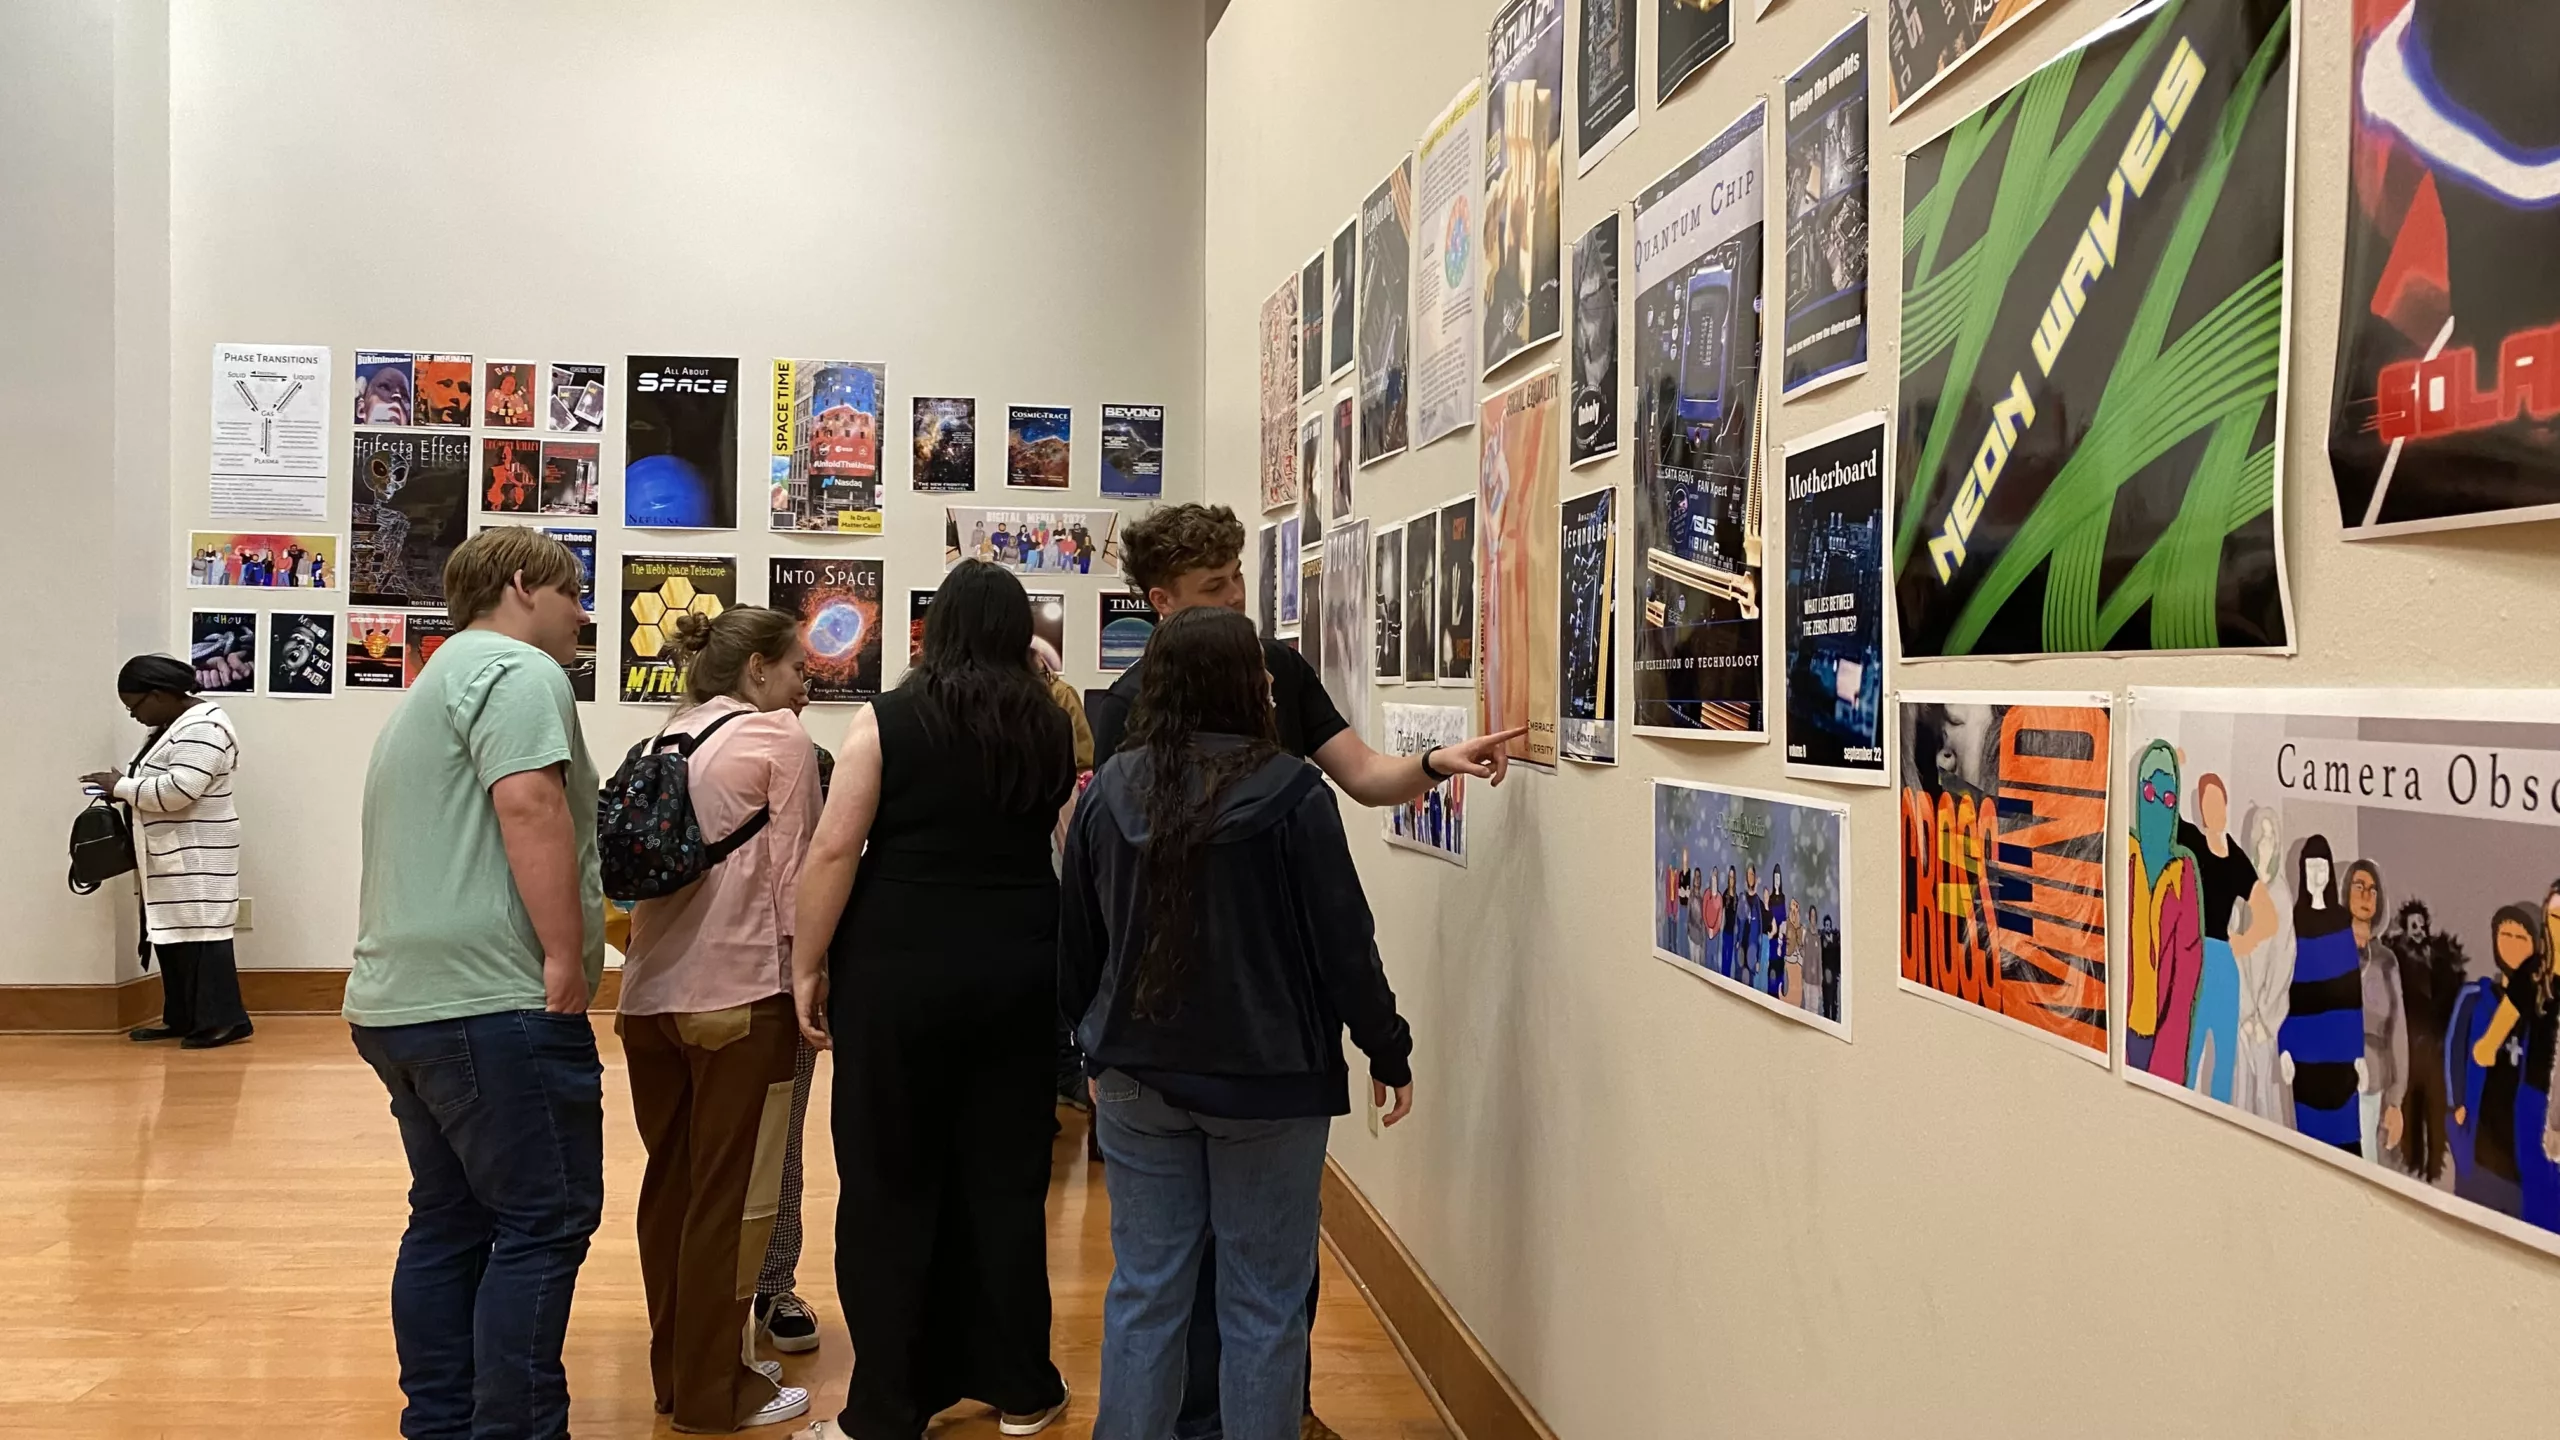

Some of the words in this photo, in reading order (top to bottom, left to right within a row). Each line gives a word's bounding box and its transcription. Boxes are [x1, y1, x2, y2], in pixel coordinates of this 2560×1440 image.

[1814, 74, 1828, 103] the
[1828, 52, 1860, 93] worlds
[1634, 204, 1701, 272] QUANTUM
[1710, 169, 1754, 216] CHIP
[1928, 370, 2036, 586] NEON
[2031, 35, 2206, 378] WAVES
[224, 353, 254, 362] PHASE
[257, 353, 318, 364] TRANSITIONS
[416, 354, 431, 362] THE
[293, 373, 315, 381] LIQUID
[664, 366, 679, 375] ALL
[682, 367, 709, 376] ABOUT
[637, 372, 728, 394] SPACE
[777, 362, 790, 400] TIME
[1526, 372, 1560, 409] EQUALITY
[1105, 407, 1161, 418] BEYOND
[776, 402, 789, 451] SPACE
[354, 434, 413, 453] Trifecta
[421, 436, 468, 454] Effect
[834, 478, 863, 488] Nasdaq
[1664, 470, 1677, 483] SATA
[1788, 448, 1877, 501] Motherboard
[1697, 480, 1709, 493] FAN
[1710, 481, 1728, 498] Xpert
[841, 522, 863, 530] Matter
[857, 514, 871, 522] Dark
[986, 511, 1021, 523] DIGITAL
[1026, 512, 1056, 524] MEDIA
[564, 533, 593, 542] choose
[631, 563, 644, 575] The
[646, 564, 666, 575] Webb
[690, 565, 726, 577] Telescope
[776, 564, 815, 585] INTO
[825, 565, 876, 586] SPACE
[1110, 598, 1149, 610] TIME
[1804, 597, 1817, 615] WHAT
[1818, 596, 1829, 613] LIES
[1829, 593, 1854, 612] BETWEEN
[1803, 620, 1812, 636] THE
[1812, 619, 1828, 635] ZEROS
[1828, 618, 1839, 634] AND
[1839, 615, 1857, 632] ONES?
[1646, 658, 1682, 671] GENERATION
[1685, 657, 1695, 669] OF
[1698, 654, 1760, 669] TECHNOLOGY
[1527, 719, 1555, 733] EMBRACE
[1396, 730, 1416, 757] Digital
[1844, 745, 1873, 762] september
[1873, 746, 1882, 762] 22
[2276, 742, 2423, 801] Camera
[1902, 785, 2004, 1013] CROSS
